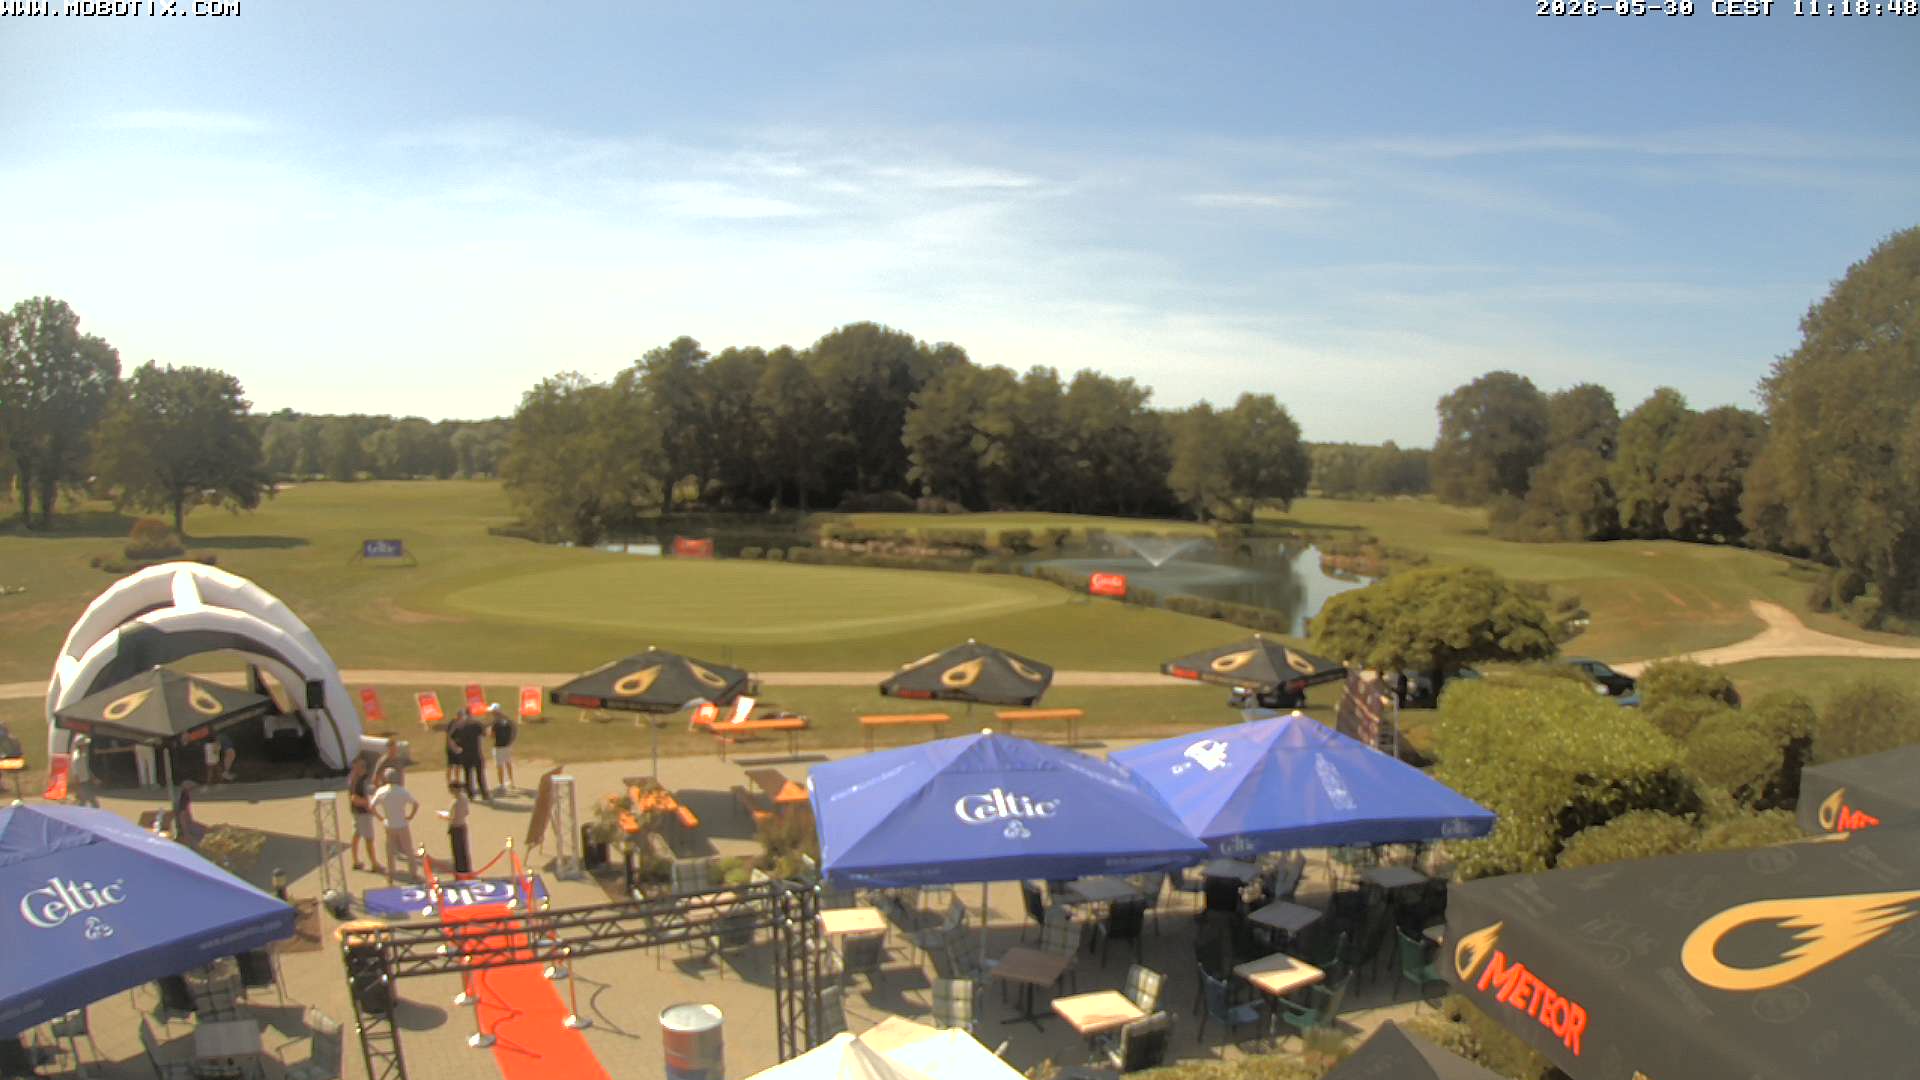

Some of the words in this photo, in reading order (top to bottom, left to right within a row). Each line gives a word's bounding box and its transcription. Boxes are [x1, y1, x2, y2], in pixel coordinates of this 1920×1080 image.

[955, 787, 1060, 823] Celtic
[20, 876, 127, 928] Celtic
[1477, 950, 1587, 1057] METEOR
